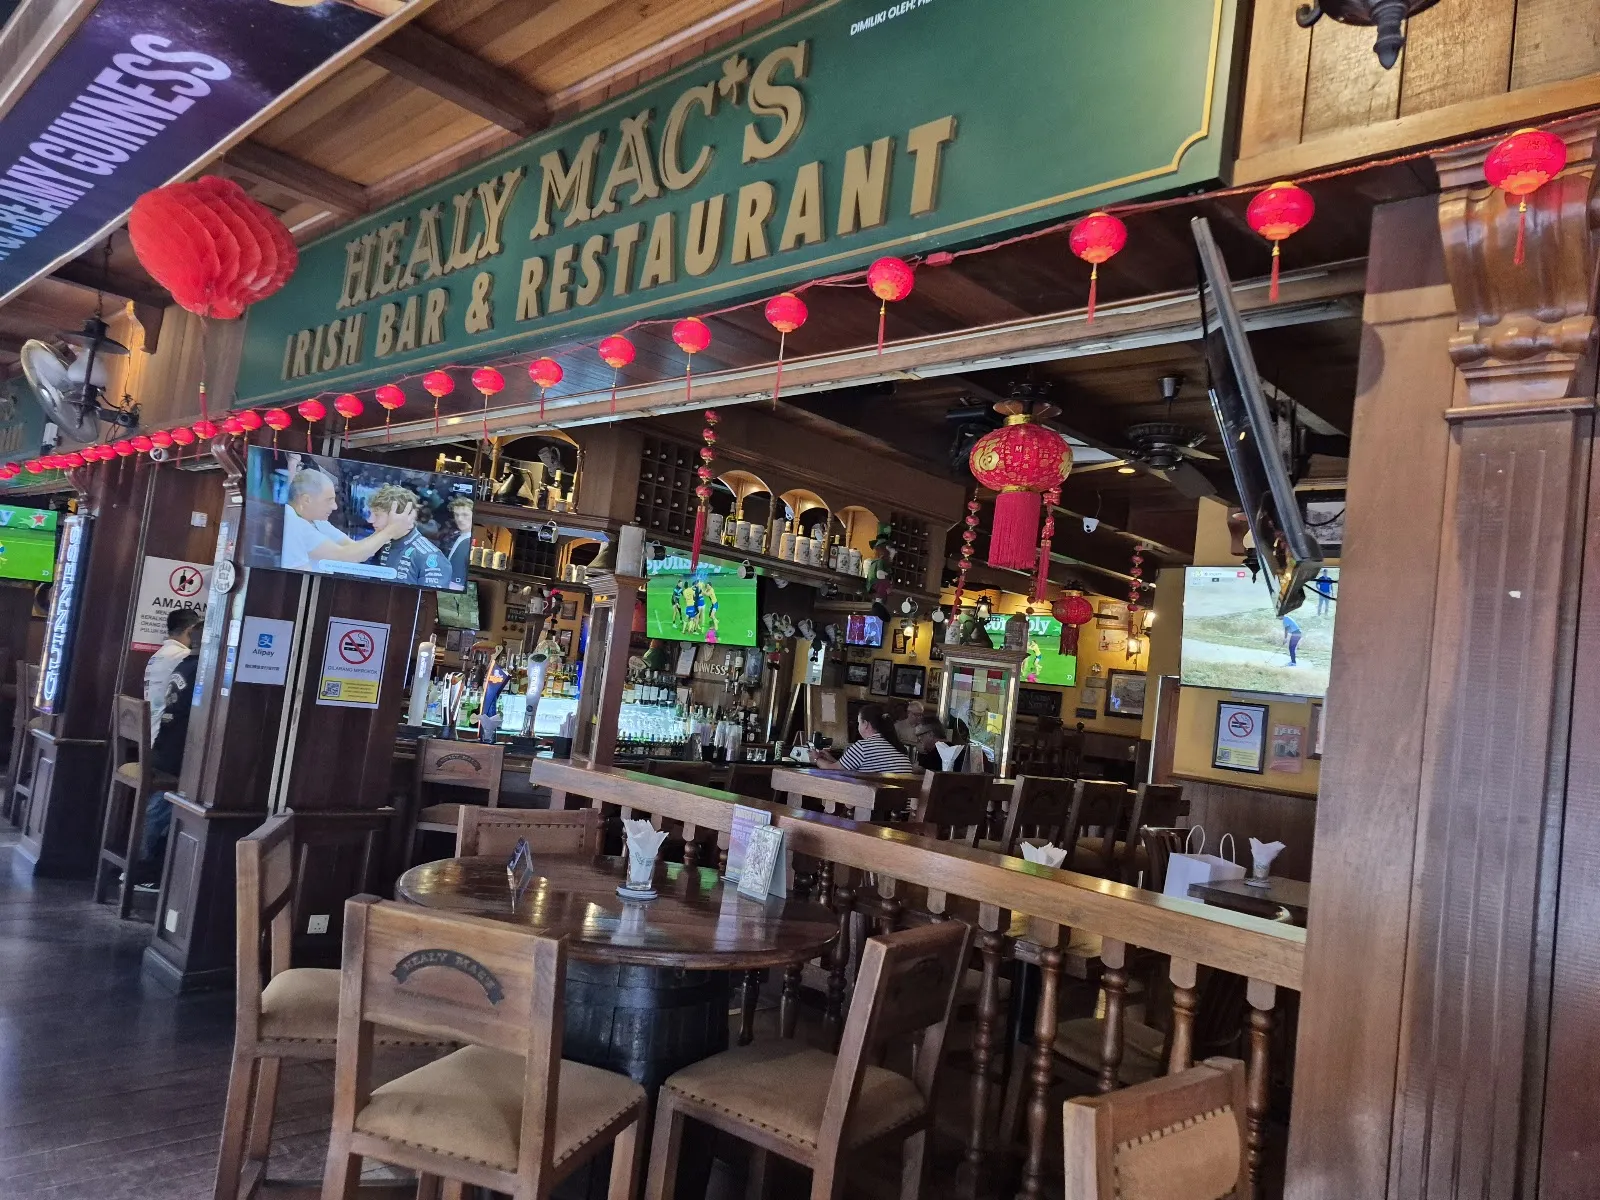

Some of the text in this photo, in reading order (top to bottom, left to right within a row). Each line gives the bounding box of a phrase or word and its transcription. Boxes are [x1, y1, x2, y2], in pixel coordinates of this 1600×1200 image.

[850, 10, 886, 36] DIMILIKI
[29, 34, 232, 175] GUINNESS
[336, 40, 808, 310] HEALY MAC'S
[281, 115, 956, 380] IRISH BAR & RESTAURANT
[43, 526, 82, 701] GUINNESS
[252, 648, 275, 657] Alipay
